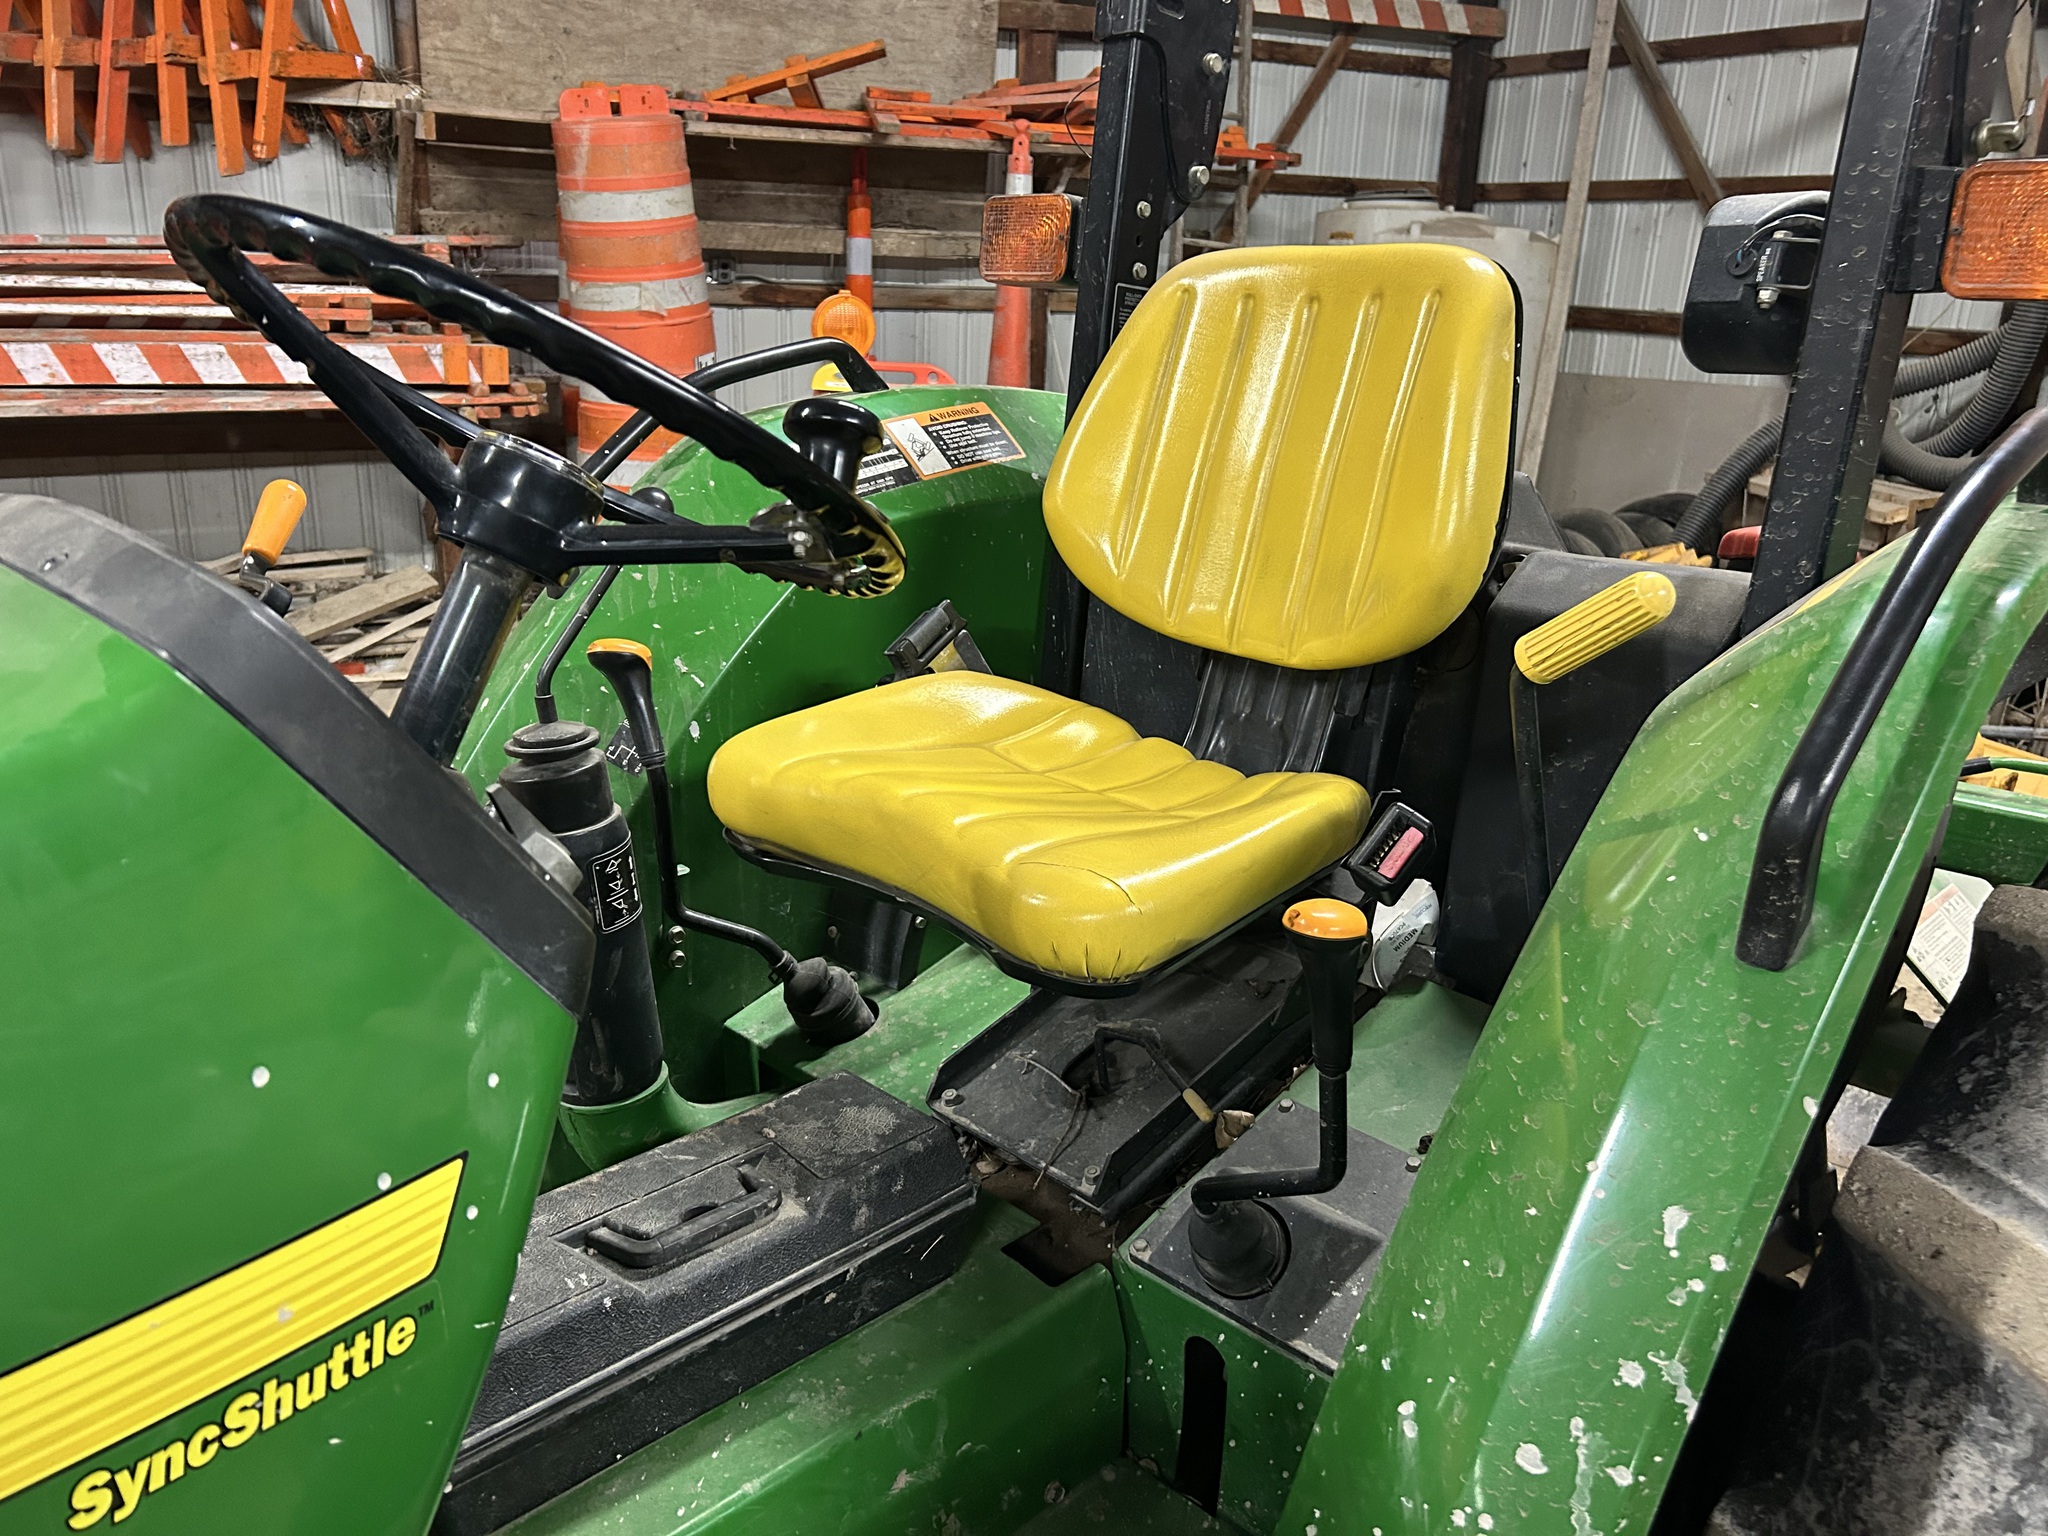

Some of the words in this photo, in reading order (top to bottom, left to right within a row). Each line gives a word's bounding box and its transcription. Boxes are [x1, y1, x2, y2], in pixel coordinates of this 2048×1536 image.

[938, 407, 979, 419] WARNING
[1393, 927, 1419, 952] MEDIUM
[67, 1315, 418, 1533] SyncShuttle
